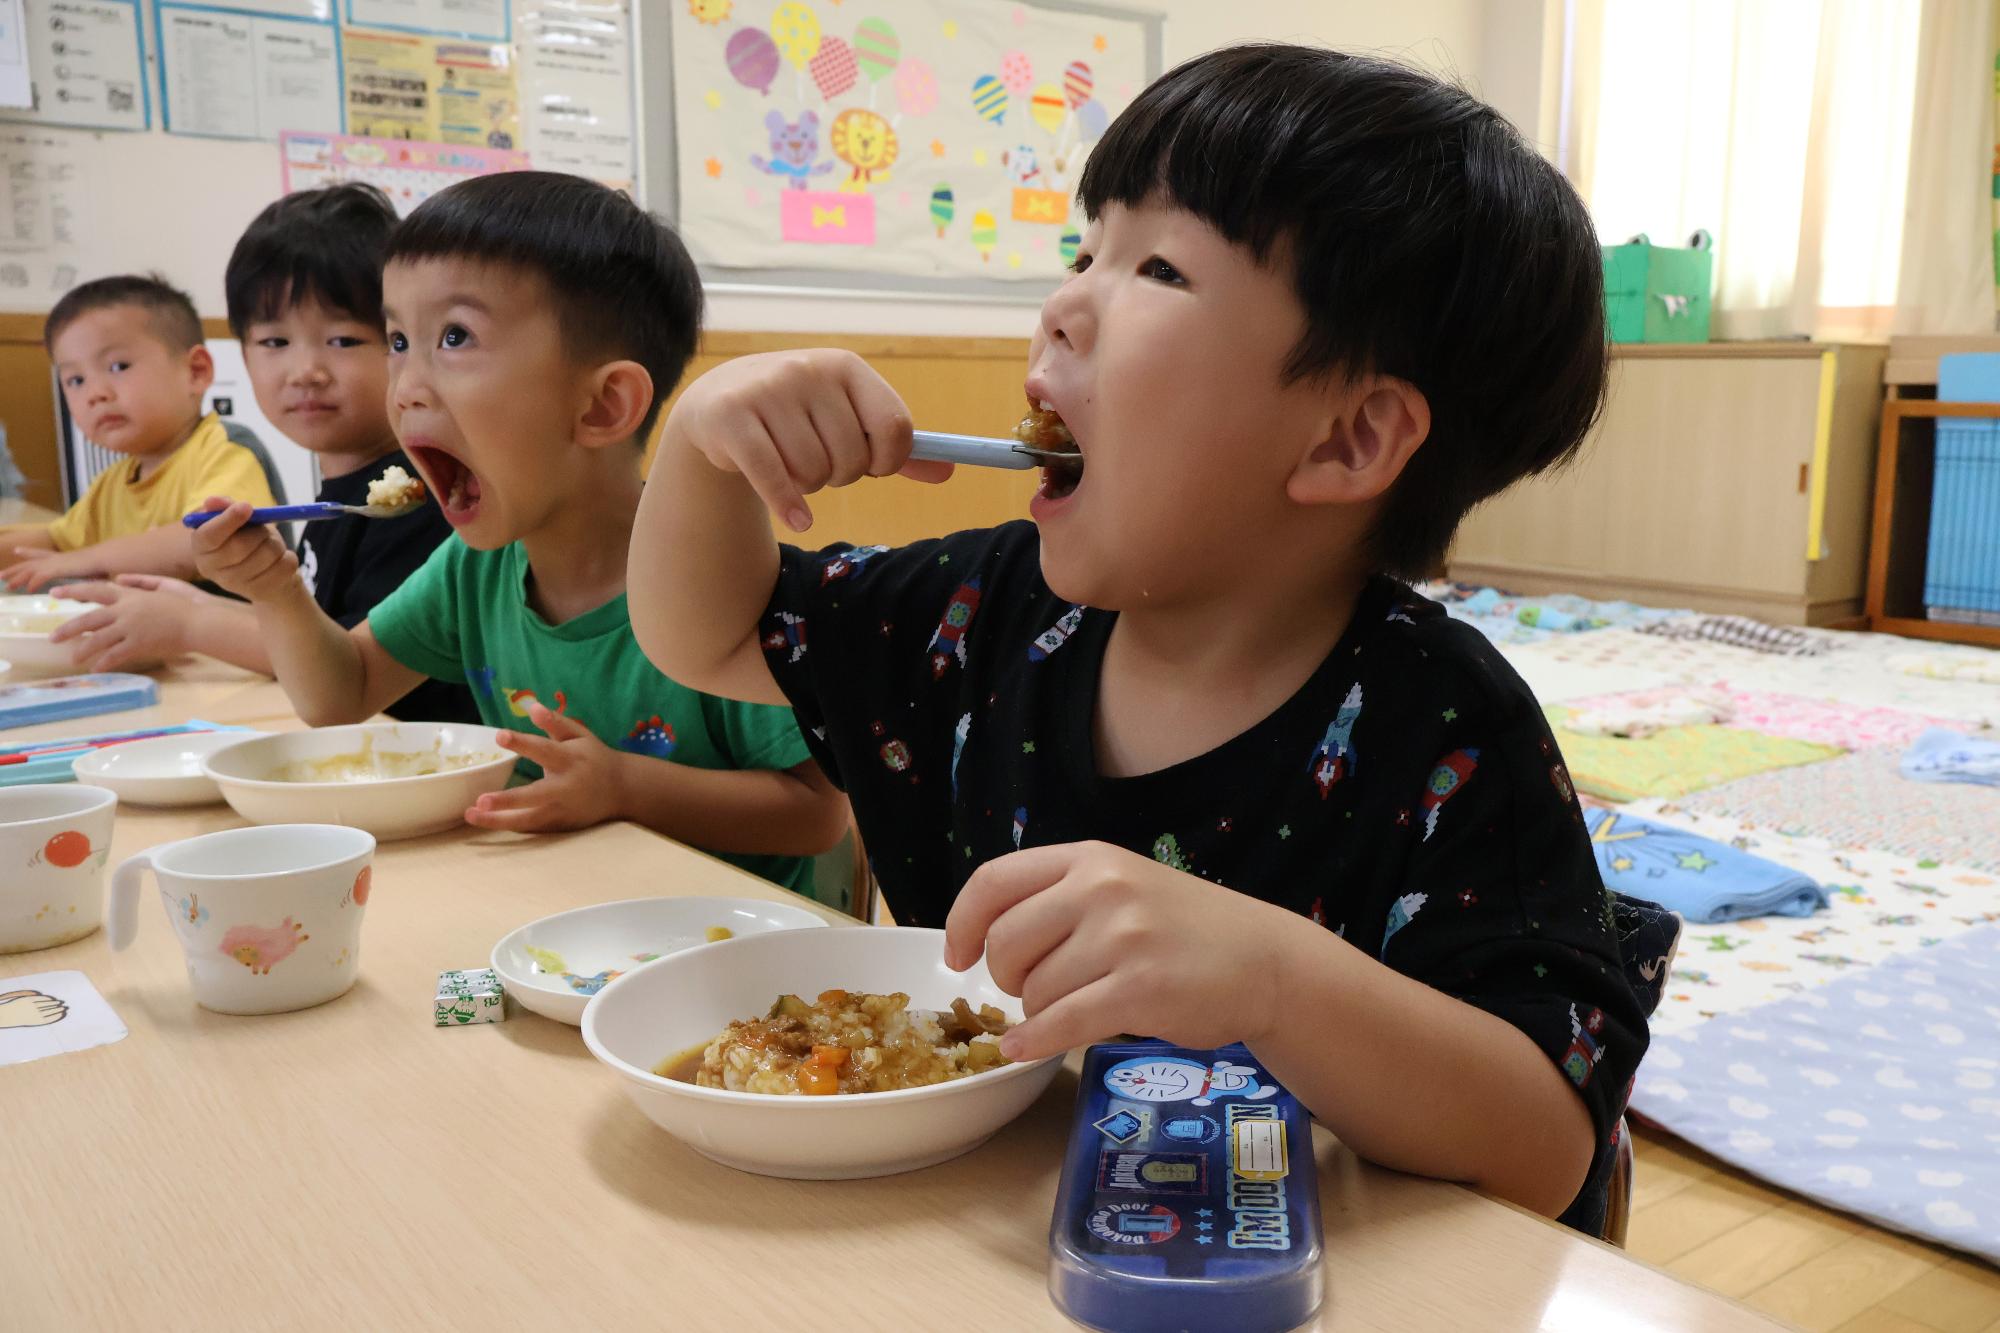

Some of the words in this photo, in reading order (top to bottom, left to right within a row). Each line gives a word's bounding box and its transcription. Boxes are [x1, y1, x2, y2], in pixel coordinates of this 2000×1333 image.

[1109, 1153, 1148, 1189] Ankipan
[1107, 1202, 1151, 1214] Door
[1093, 1209, 1145, 1245] Dokodemo
[1231, 1211, 1286, 1247] I'M
